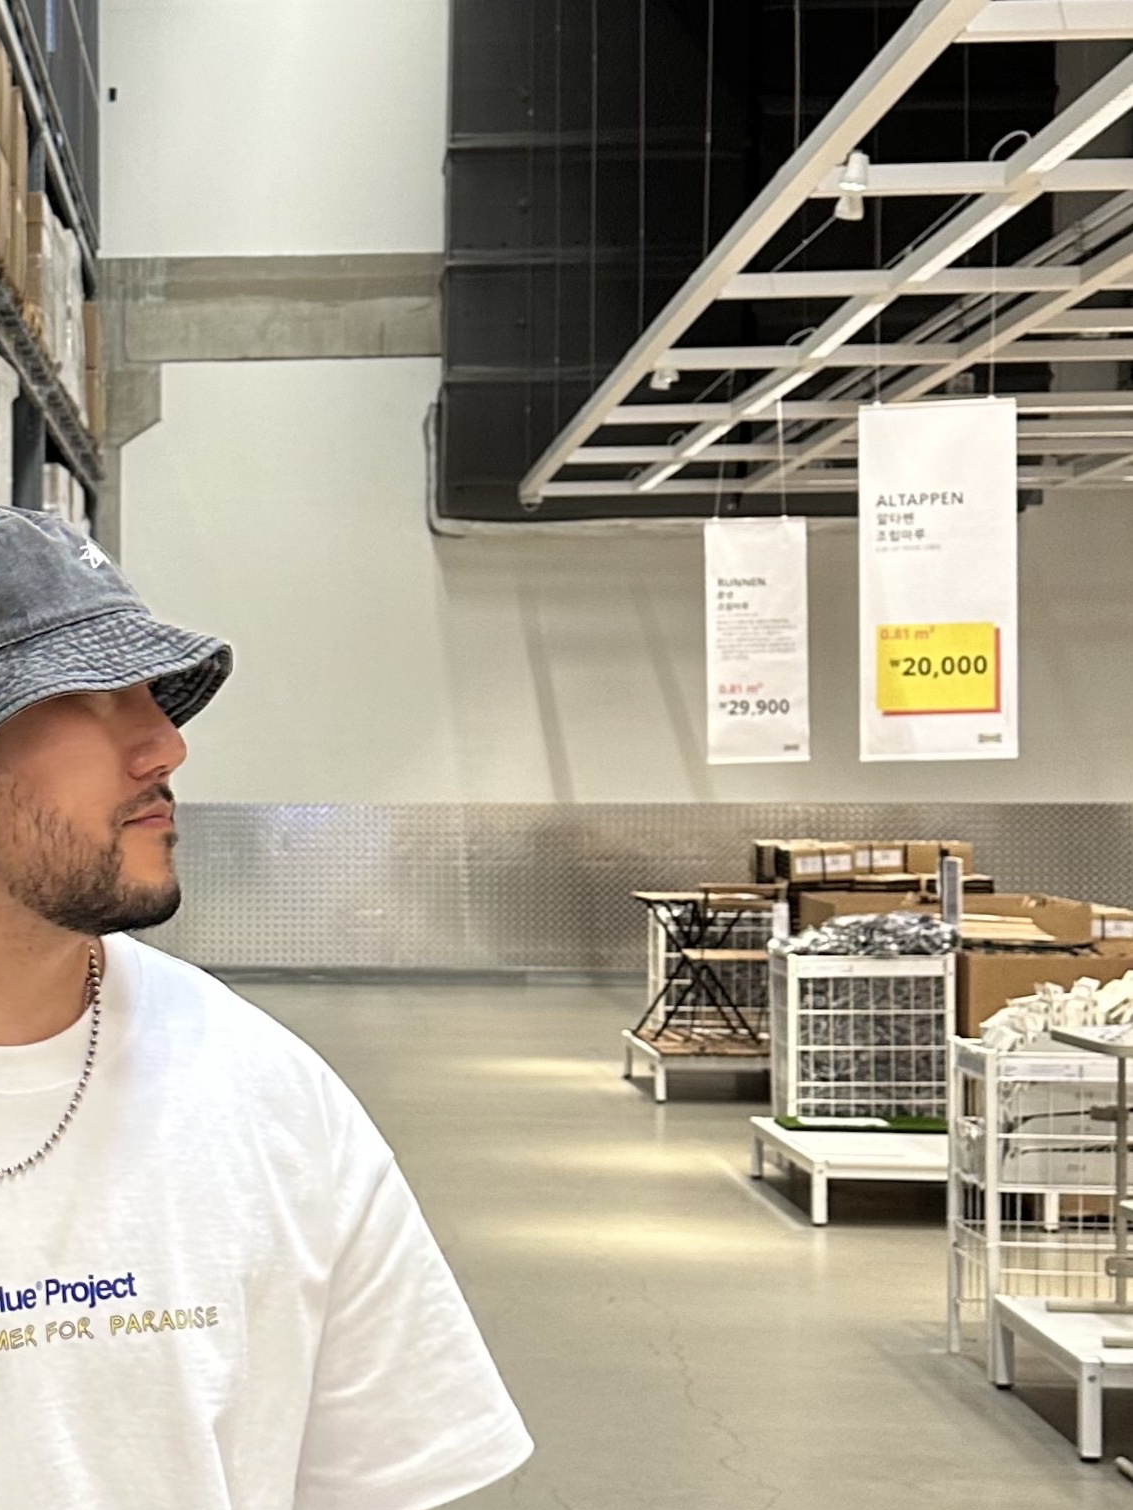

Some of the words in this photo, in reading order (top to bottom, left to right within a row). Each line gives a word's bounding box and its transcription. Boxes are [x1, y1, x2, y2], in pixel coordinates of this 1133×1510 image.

[876, 491, 964, 507] ALTAPPEN
[879, 627, 910, 640] 0.81
[44, 1272, 138, 1308] Project
[45, 1316, 95, 1343] FOR
[109, 1306, 220, 1336] PARADISE
